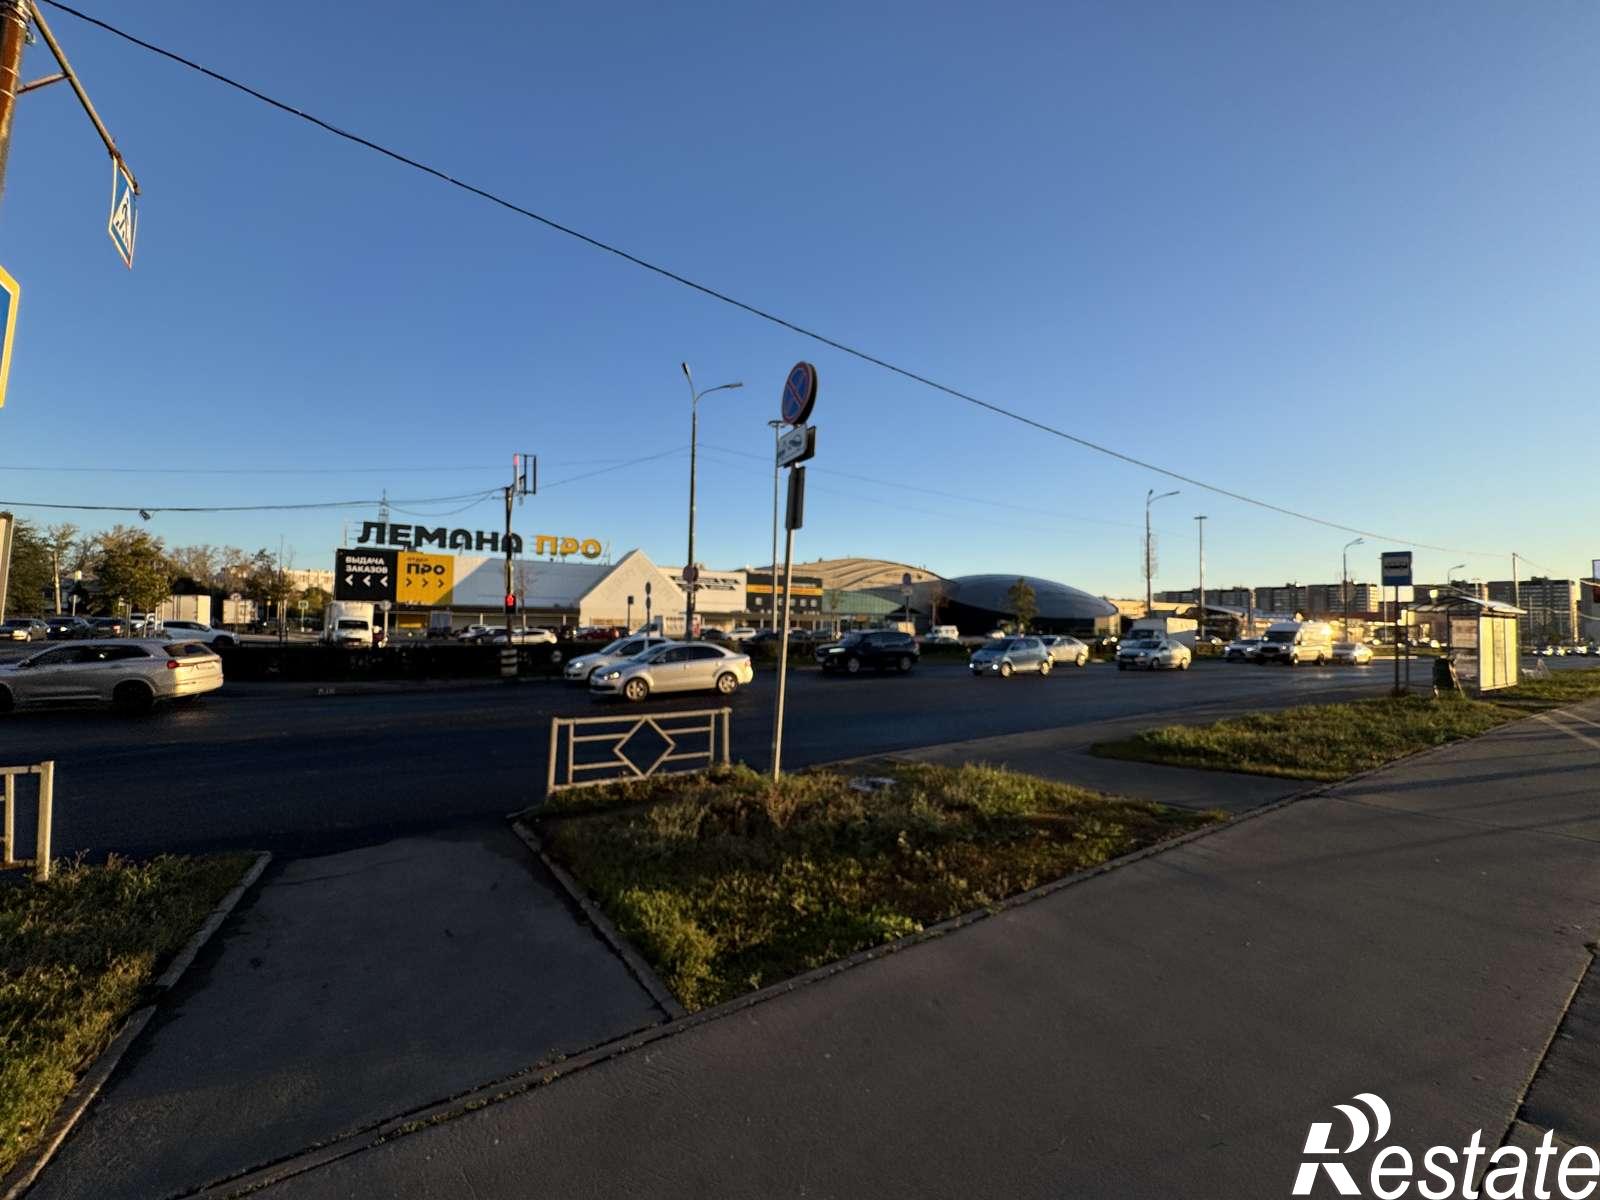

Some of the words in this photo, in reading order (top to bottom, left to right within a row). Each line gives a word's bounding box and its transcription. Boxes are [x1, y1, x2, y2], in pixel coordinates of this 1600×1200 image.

[357, 521, 523, 553] ЛЕМАНА
[535, 534, 602, 559] ПРО
[345, 556, 385, 565] ВЫДАЧА
[345, 564, 389, 574] ЗАКАЗОВ
[407, 563, 446, 576] ПРО
